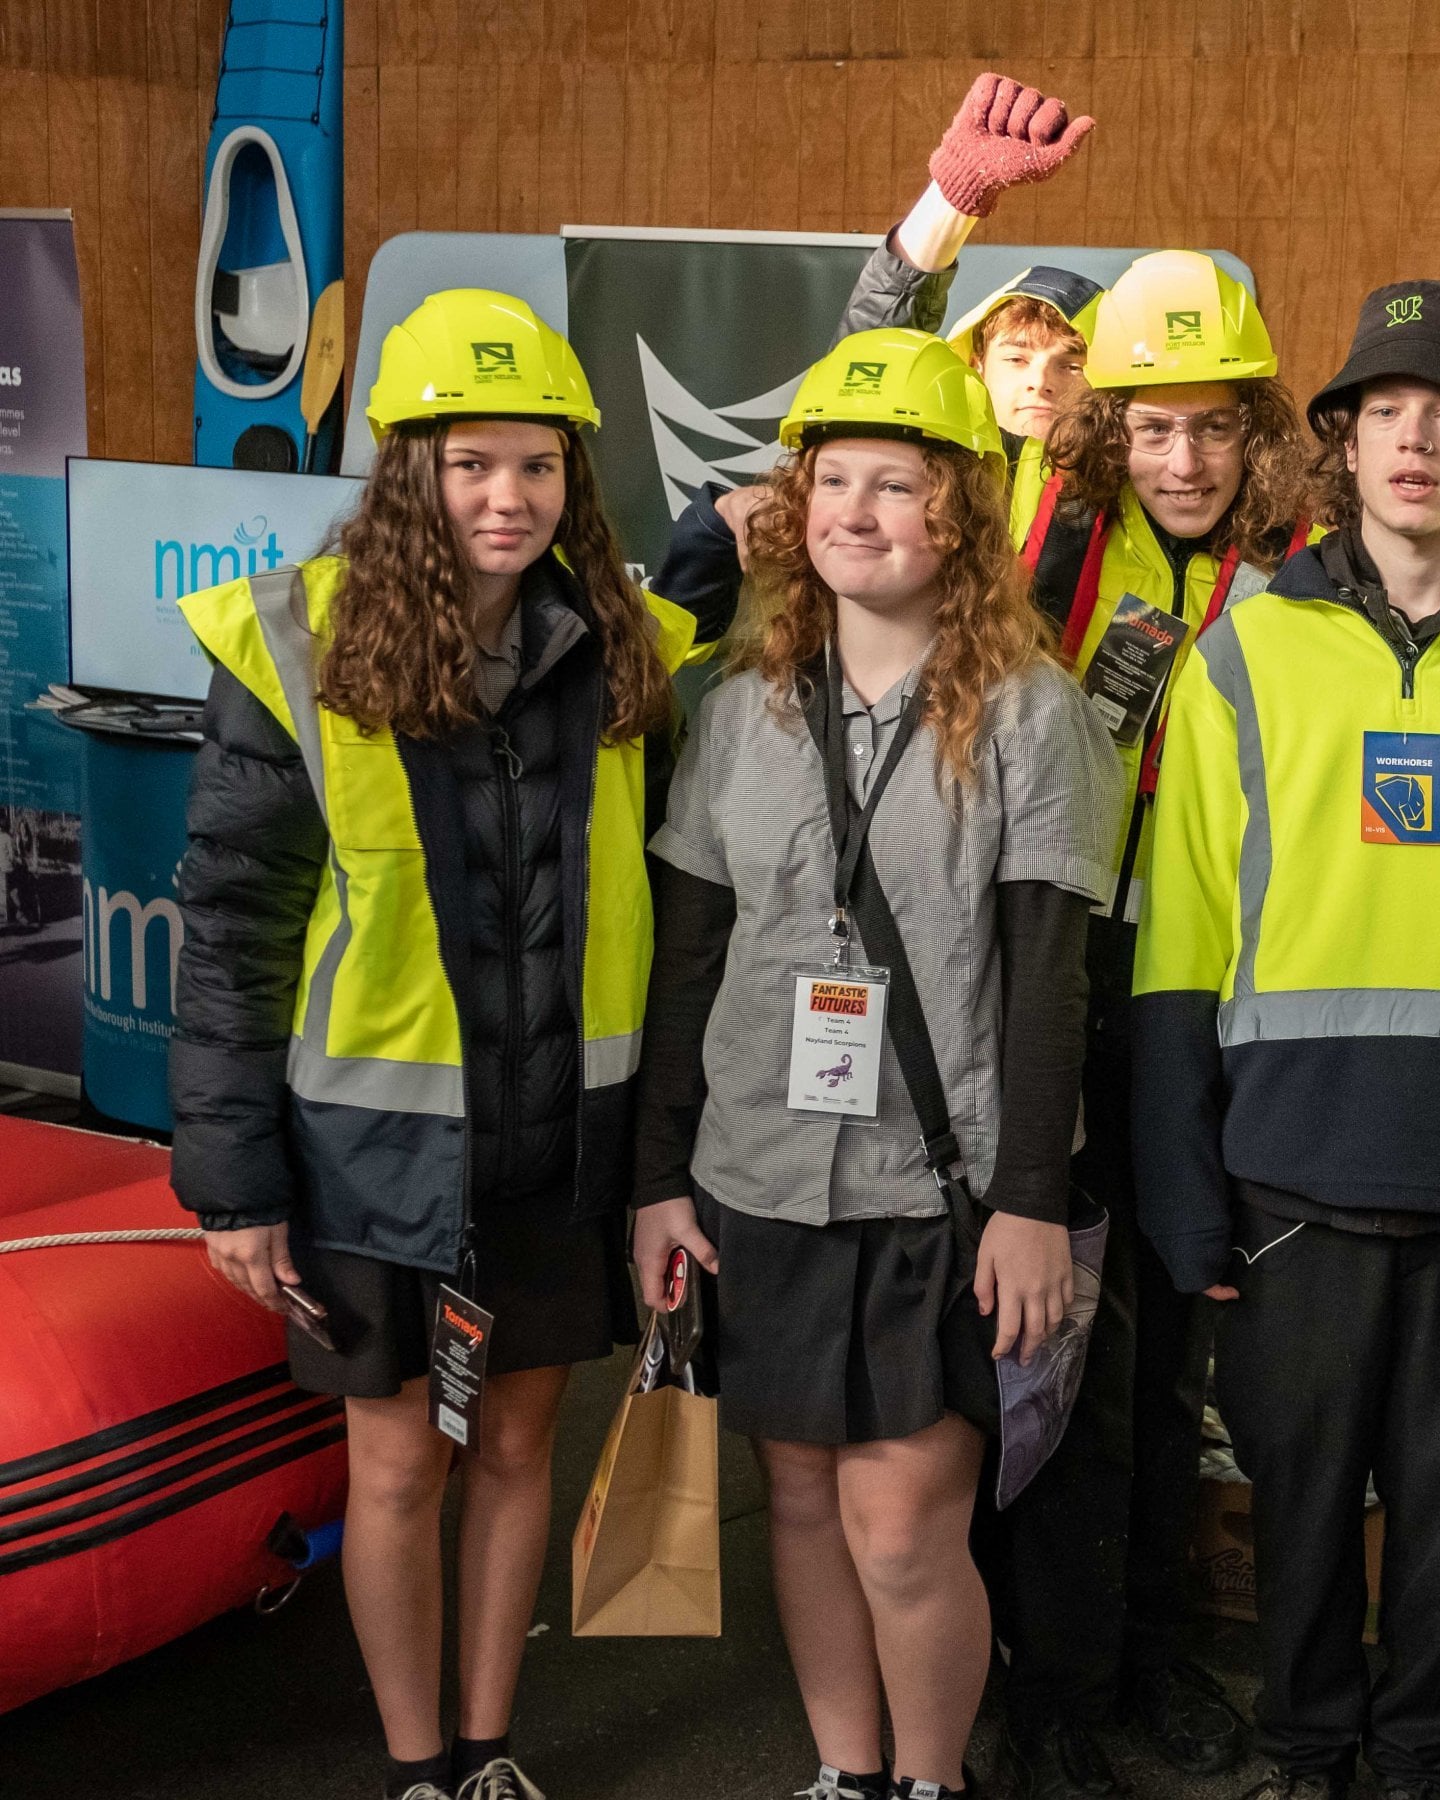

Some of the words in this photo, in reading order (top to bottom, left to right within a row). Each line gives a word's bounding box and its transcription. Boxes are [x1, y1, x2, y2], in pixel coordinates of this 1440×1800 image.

[155, 532, 284, 600] nmit
[1375, 756, 1434, 768] WORKHORSE
[1365, 825, 1386, 834] HI-VIS
[812, 983, 867, 998] FANTASTIC
[810, 996, 865, 1015] FUTURES
[825, 1027, 843, 1035] Team
[805, 1036, 833, 1046] Nayland
[834, 1039, 867, 1049] Scorpions
[444, 1304, 484, 1345] Tornado
